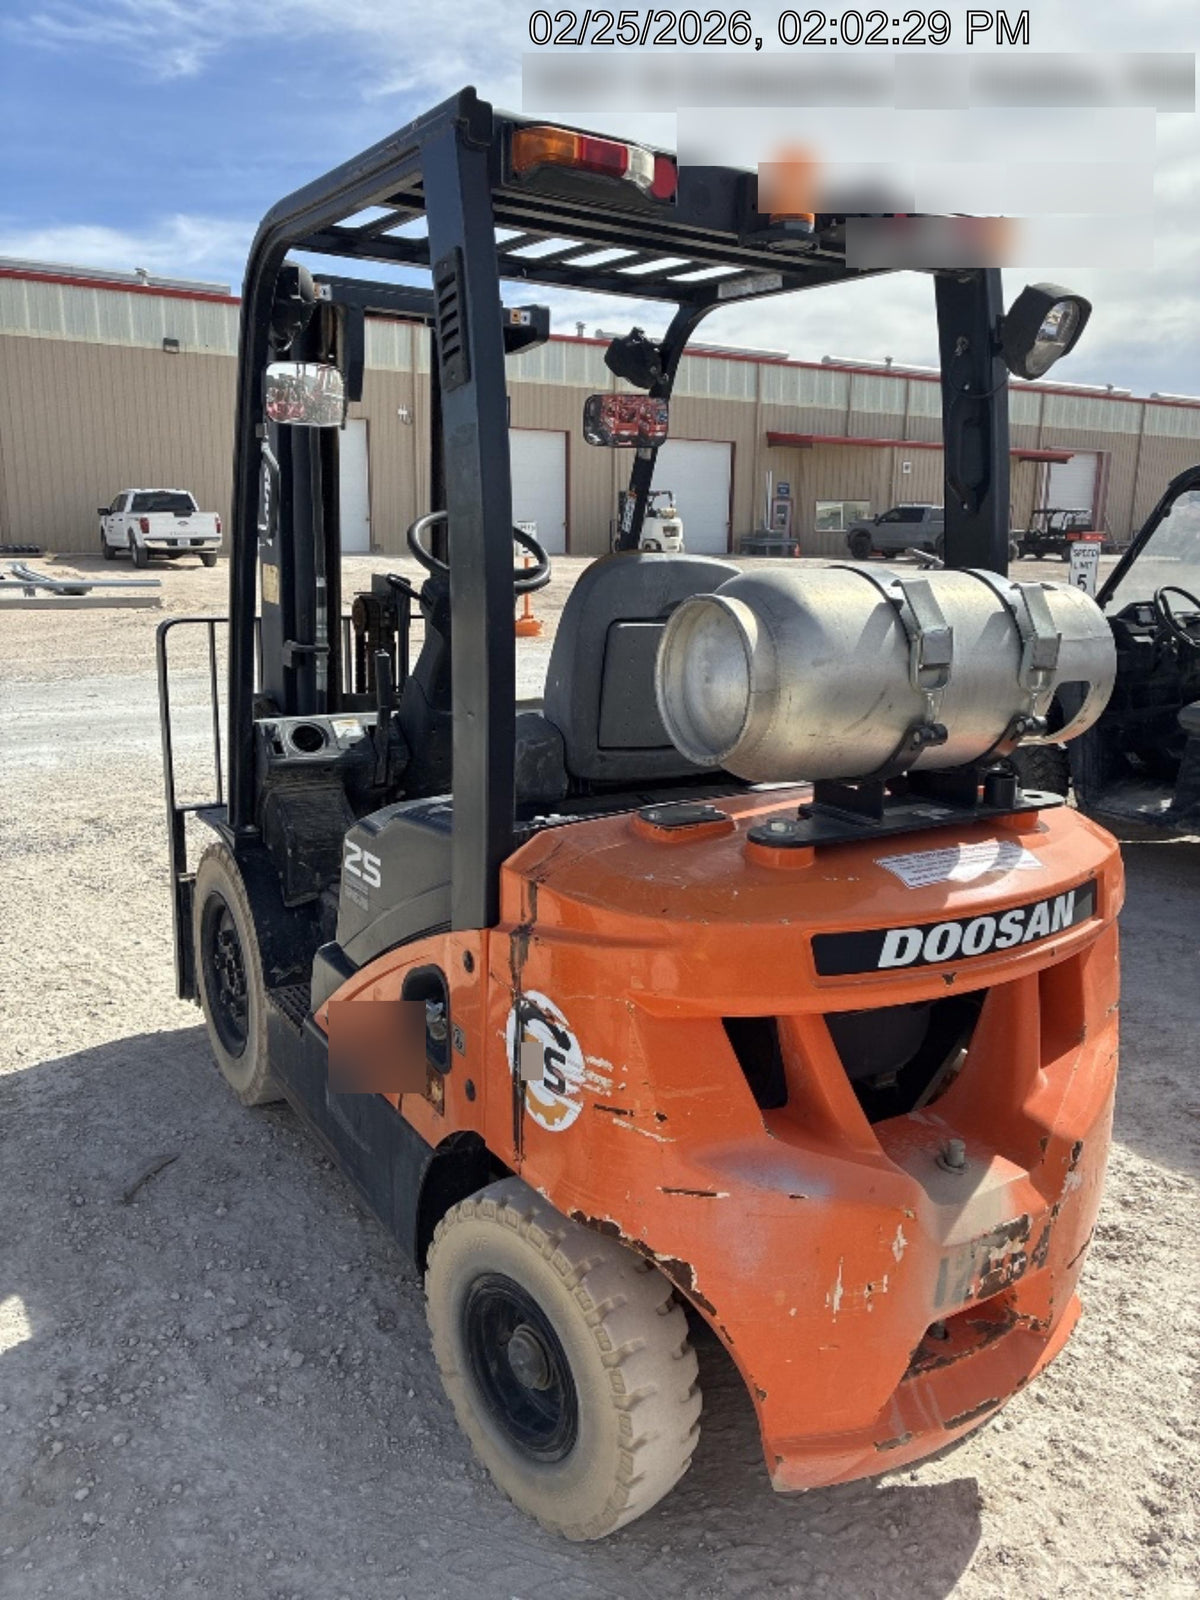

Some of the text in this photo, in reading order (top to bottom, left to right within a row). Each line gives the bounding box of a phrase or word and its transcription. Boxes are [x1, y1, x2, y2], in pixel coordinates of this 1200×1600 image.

[1074, 561, 1093, 569] LMIT
[1077, 574, 1087, 592] 5
[877, 890, 1075, 968] DOOSAN
